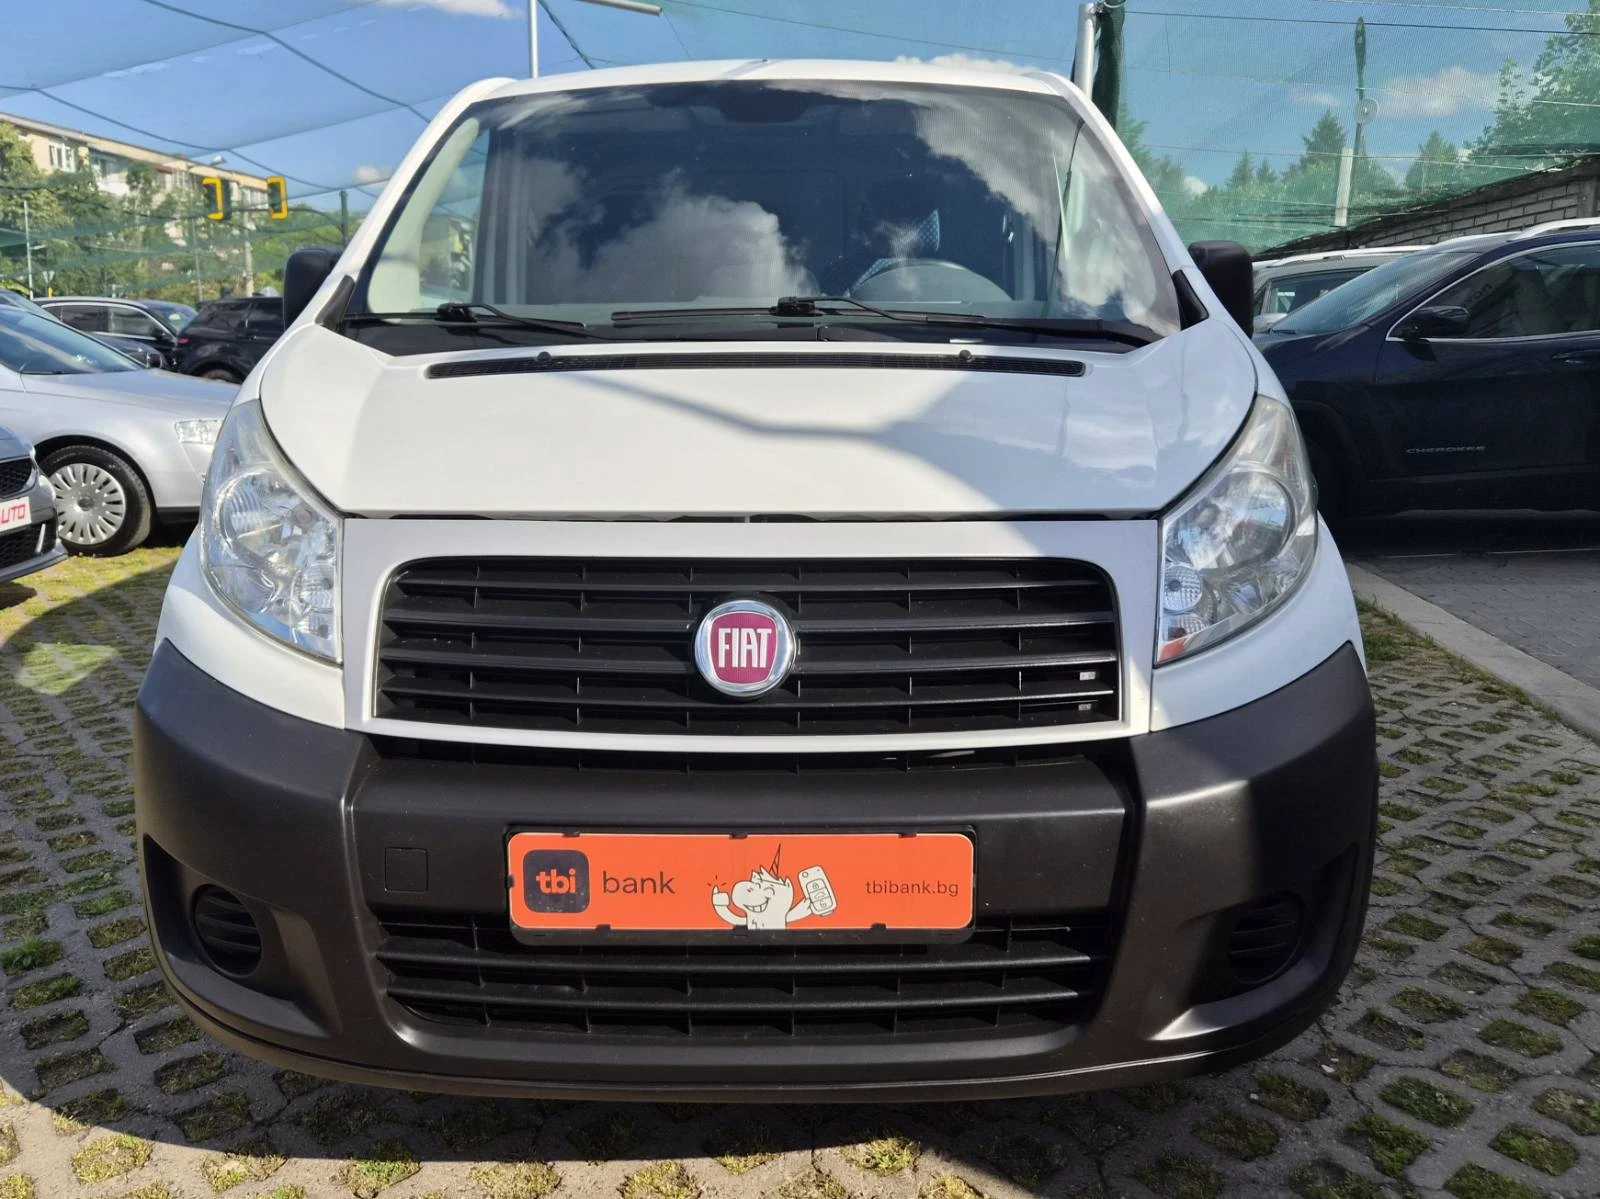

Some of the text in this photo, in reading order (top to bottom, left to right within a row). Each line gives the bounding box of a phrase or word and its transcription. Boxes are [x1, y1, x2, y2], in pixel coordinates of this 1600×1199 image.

[1405, 446, 1486, 454] CHEROKEE
[718, 627, 772, 668] FIAT
[536, 868, 676, 895] tbi bank
[865, 880, 959, 897] tbibank.bg
